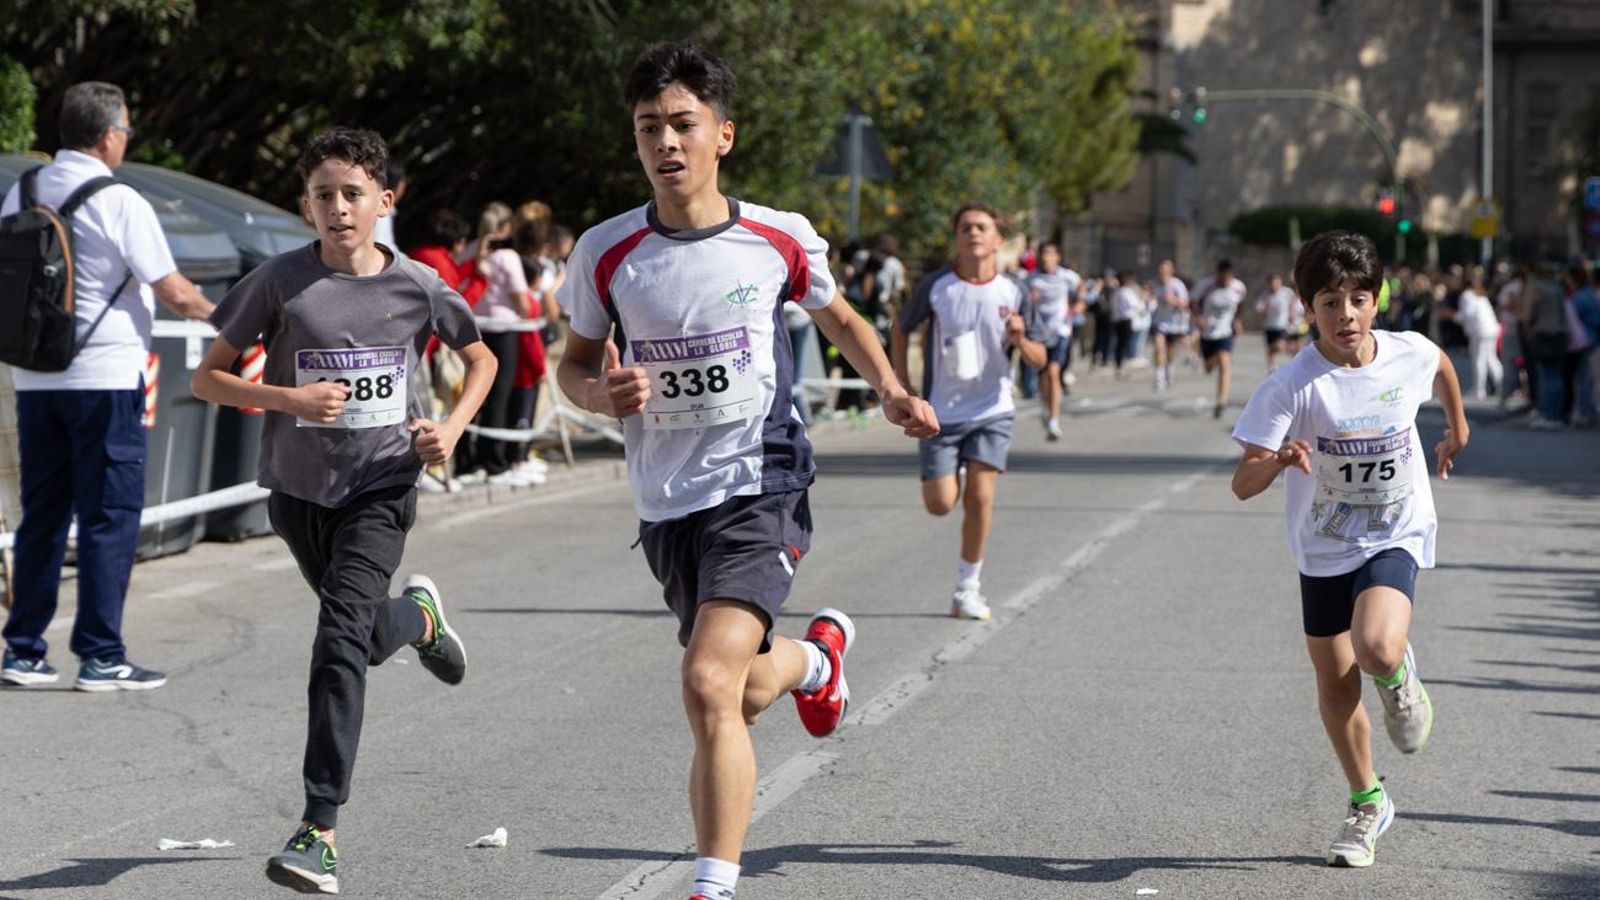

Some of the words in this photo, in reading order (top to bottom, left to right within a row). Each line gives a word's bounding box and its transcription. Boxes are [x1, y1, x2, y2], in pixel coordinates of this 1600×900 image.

[687, 337, 716, 348] CARRERA
[694, 347, 705, 356] LA
[709, 340, 738, 354] GLORIA
[316, 375, 394, 402] 88
[659, 365, 729, 399] 338
[1338, 459, 1396, 483] 175
